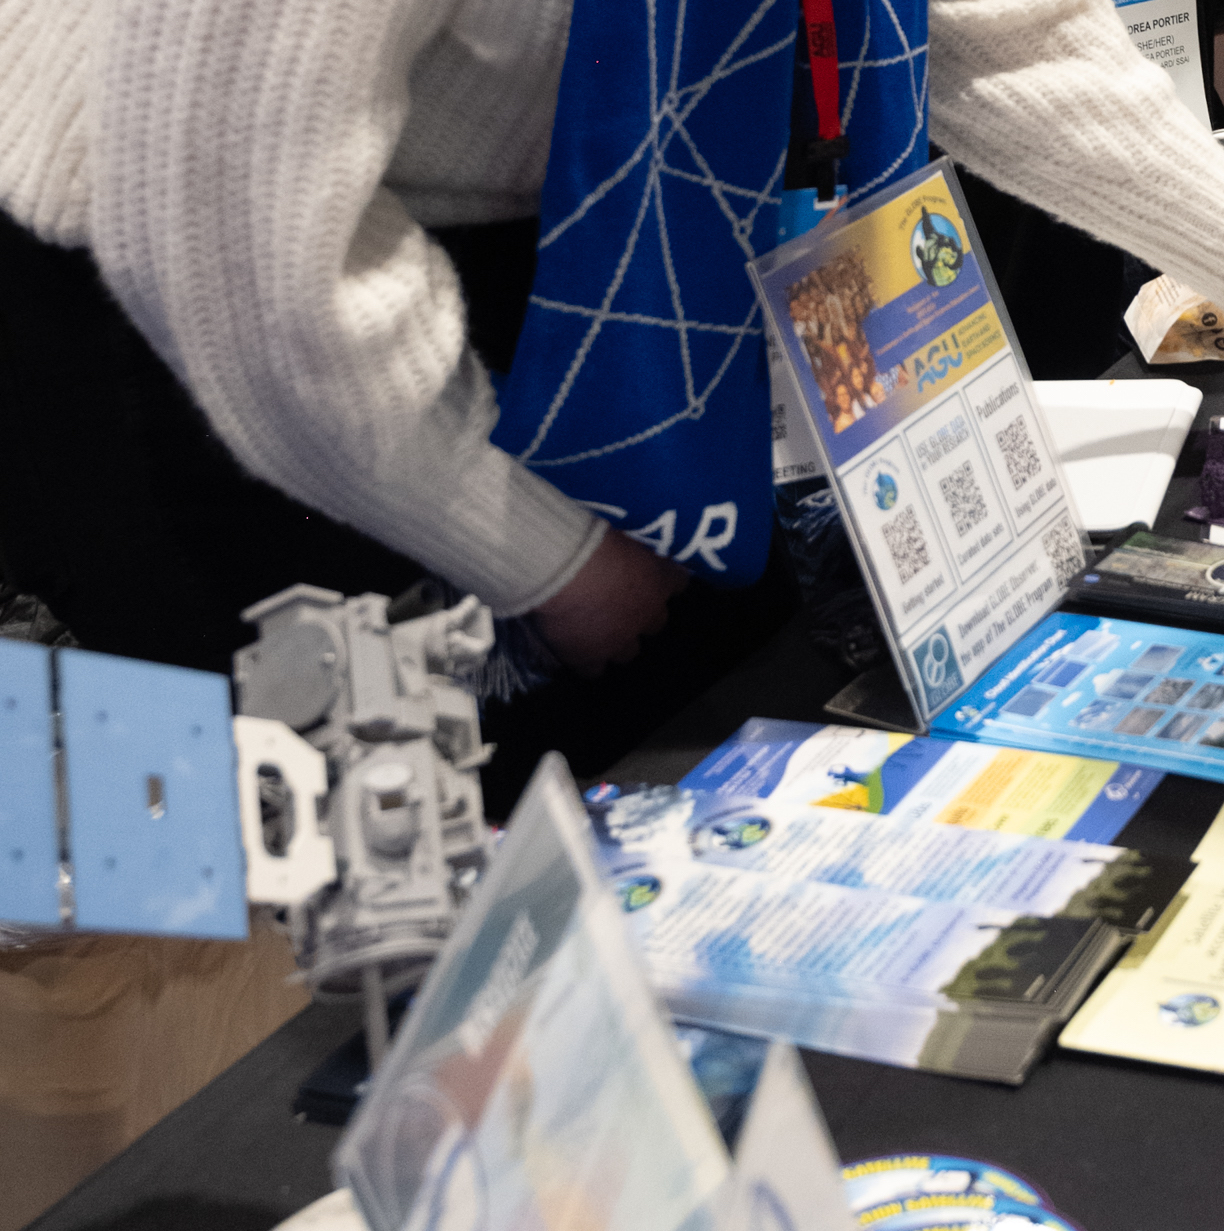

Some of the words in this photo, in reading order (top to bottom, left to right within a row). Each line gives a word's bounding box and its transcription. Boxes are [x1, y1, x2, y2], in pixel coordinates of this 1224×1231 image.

[1127, 21, 1151, 36] DREA
[1153, 11, 1190, 29] PORTIER
[1156, 45, 1185, 60] PORTIER
[975, 381, 1020, 420] Publications
[773, 461, 816, 479] EETING
[926, 446, 944, 465] YOUR
[572, 500, 739, 572] AR
[958, 604, 989, 639] Download
[988, 588, 1010, 610] GLOBE
[960, 649, 972, 667] the
[971, 642, 985, 660] app
[985, 630, 994, 645] of
[992, 618, 1006, 638] The
[1005, 603, 1026, 626] GLOBE
[1025, 576, 1054, 606] Program
